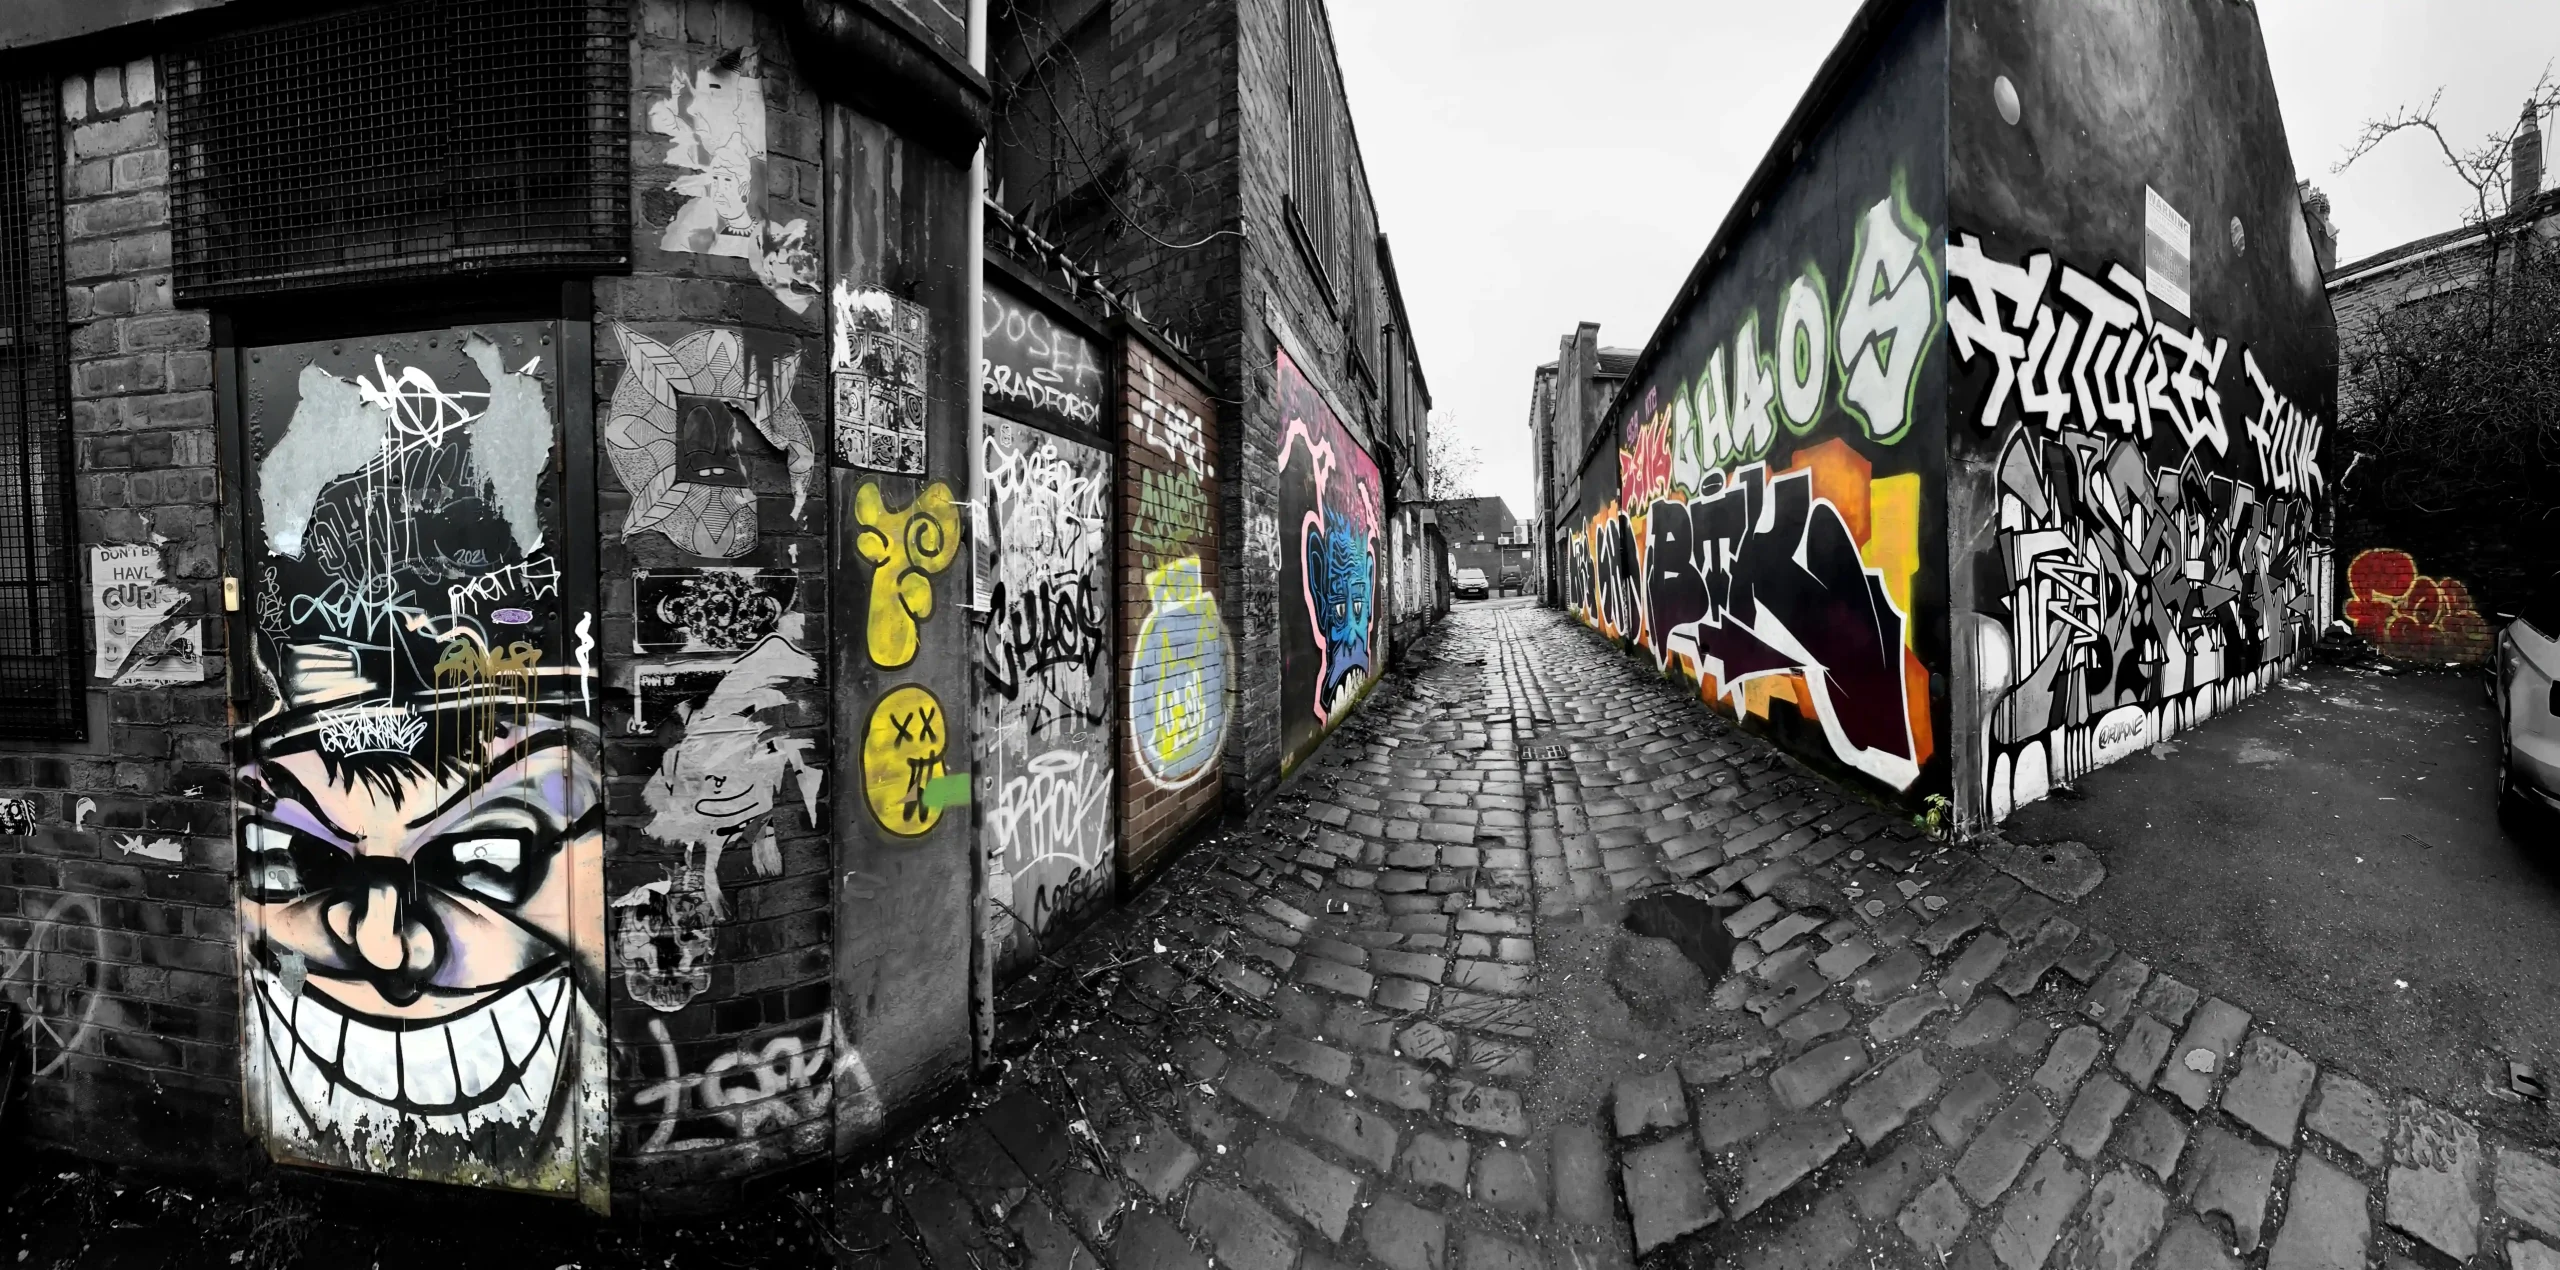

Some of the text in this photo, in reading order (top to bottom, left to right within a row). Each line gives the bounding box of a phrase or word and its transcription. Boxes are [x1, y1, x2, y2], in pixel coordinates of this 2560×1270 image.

[2147, 188, 2189, 235] WARNING
[1947, 232, 2324, 499] FUTURE FUNK
[101, 546, 137, 561] DON'T
[453, 548, 488, 565] 2021
